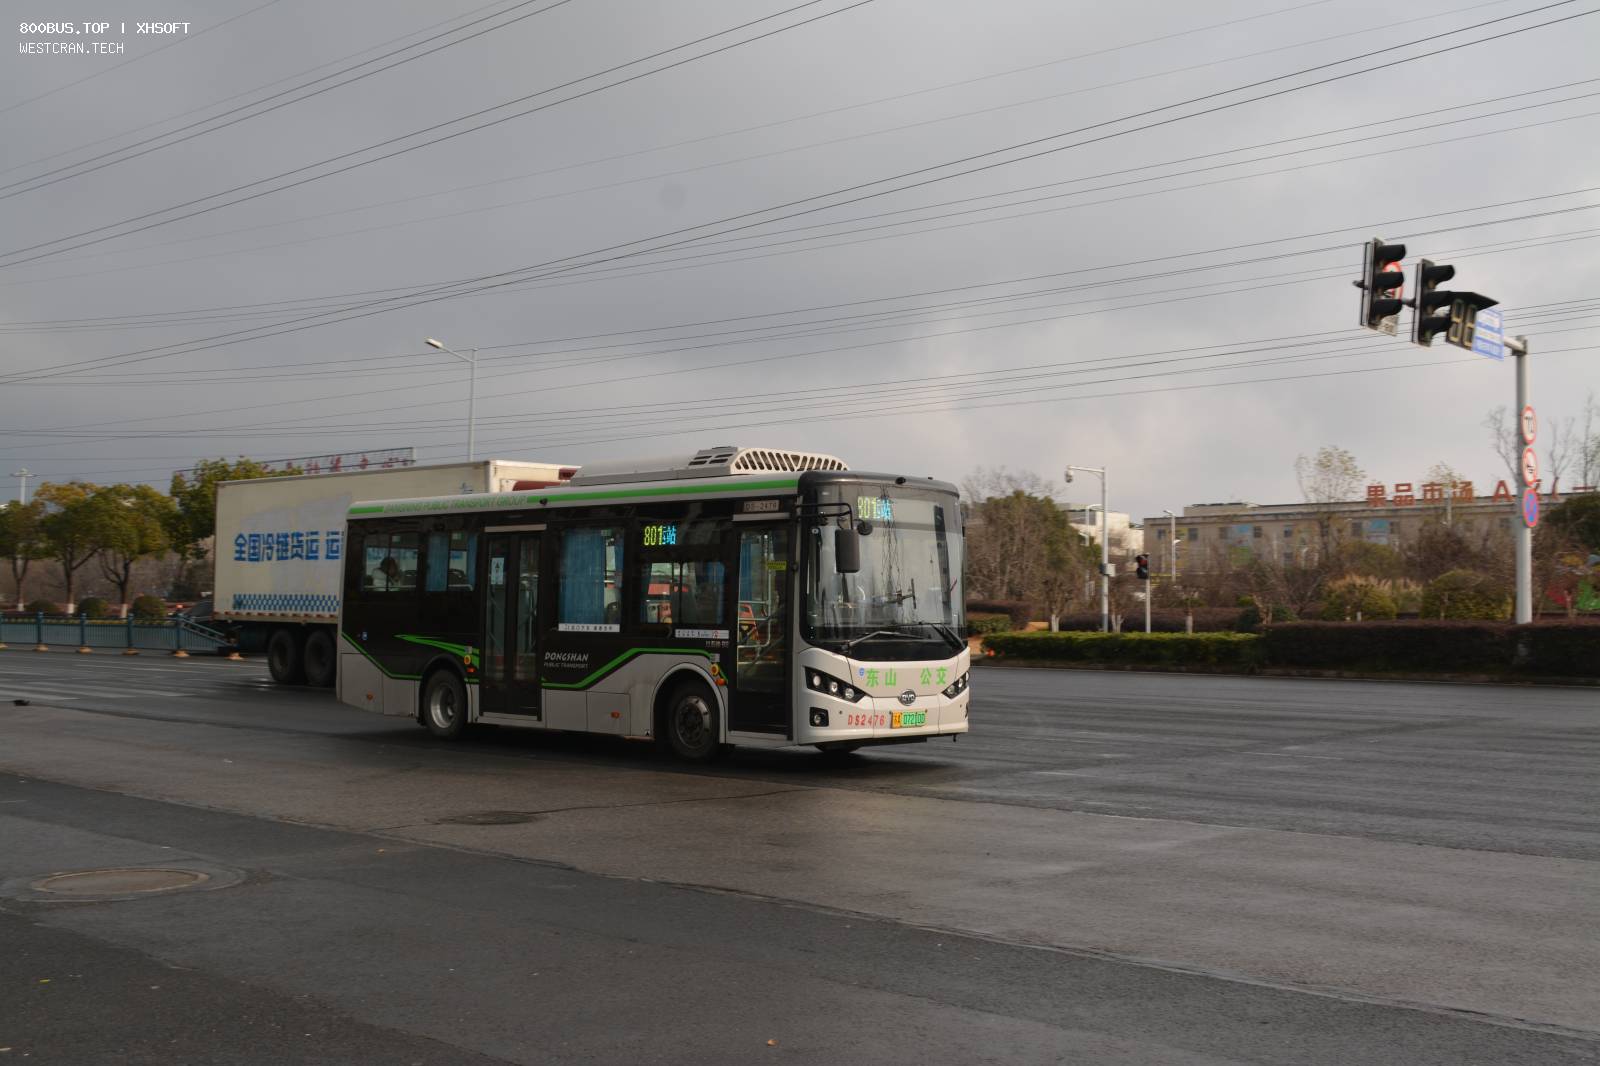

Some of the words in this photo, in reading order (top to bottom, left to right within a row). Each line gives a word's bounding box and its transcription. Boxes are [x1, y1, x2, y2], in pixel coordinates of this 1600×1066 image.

[1366, 480, 1473, 507] 果品市场
[233, 530, 320, 562] 全国冷链货运
[643, 525, 662, 546] 801
[544, 651, 589, 662] DONGSHAN
[866, 667, 897, 687] 东山
[920, 666, 948, 685] 公交
[847, 714, 886, 727] DS2476
